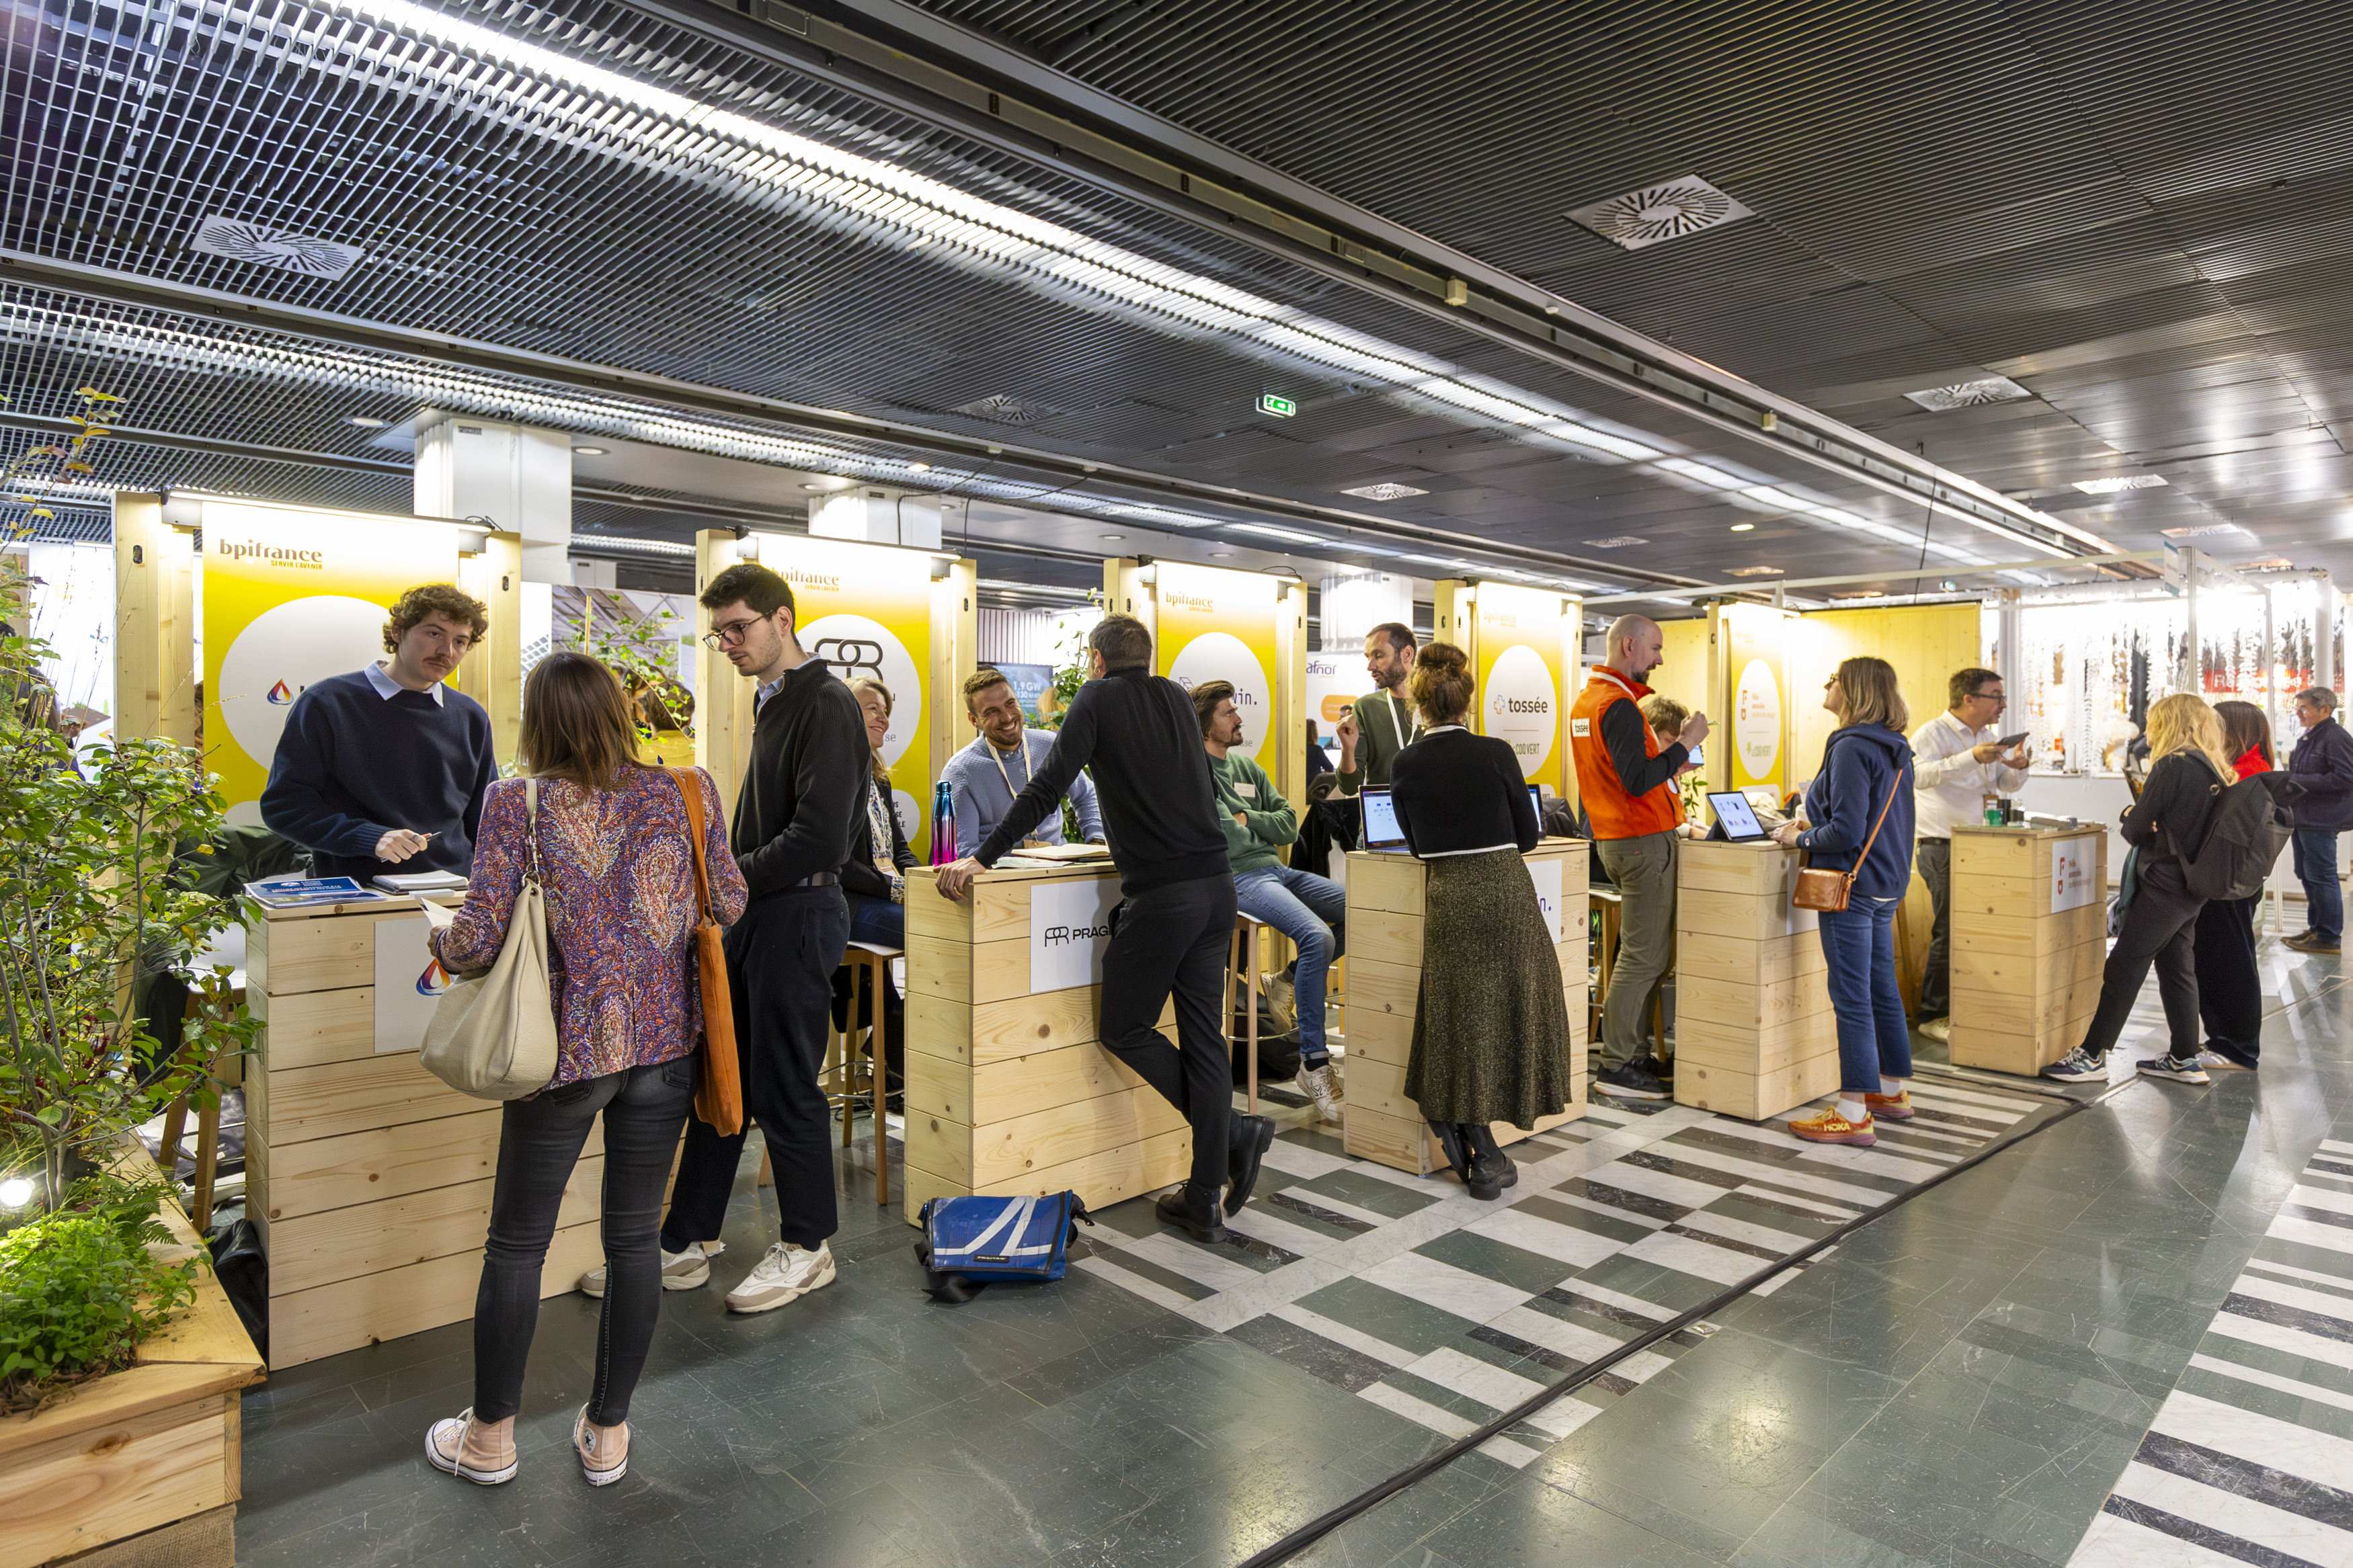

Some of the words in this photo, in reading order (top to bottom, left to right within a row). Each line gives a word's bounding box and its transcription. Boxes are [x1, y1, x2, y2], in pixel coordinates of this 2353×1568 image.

[220, 538, 323, 563] bpifrance
[296, 562, 323, 570] L'AVENIR
[1166, 591, 1213, 608] bpifrance
[1306, 661, 1337, 675] afnor
[1013, 682, 1025, 690] 1.9
[1026, 682, 1041, 691] GW
[1509, 697, 1548, 713] tossée
[1515, 743, 1526, 755] COQ
[1526, 743, 1540, 755] VERT
[1073, 925, 1111, 940] PRAG
[1823, 1122, 1850, 1132] HOKA
[816, 1257, 828, 1270] FILA
